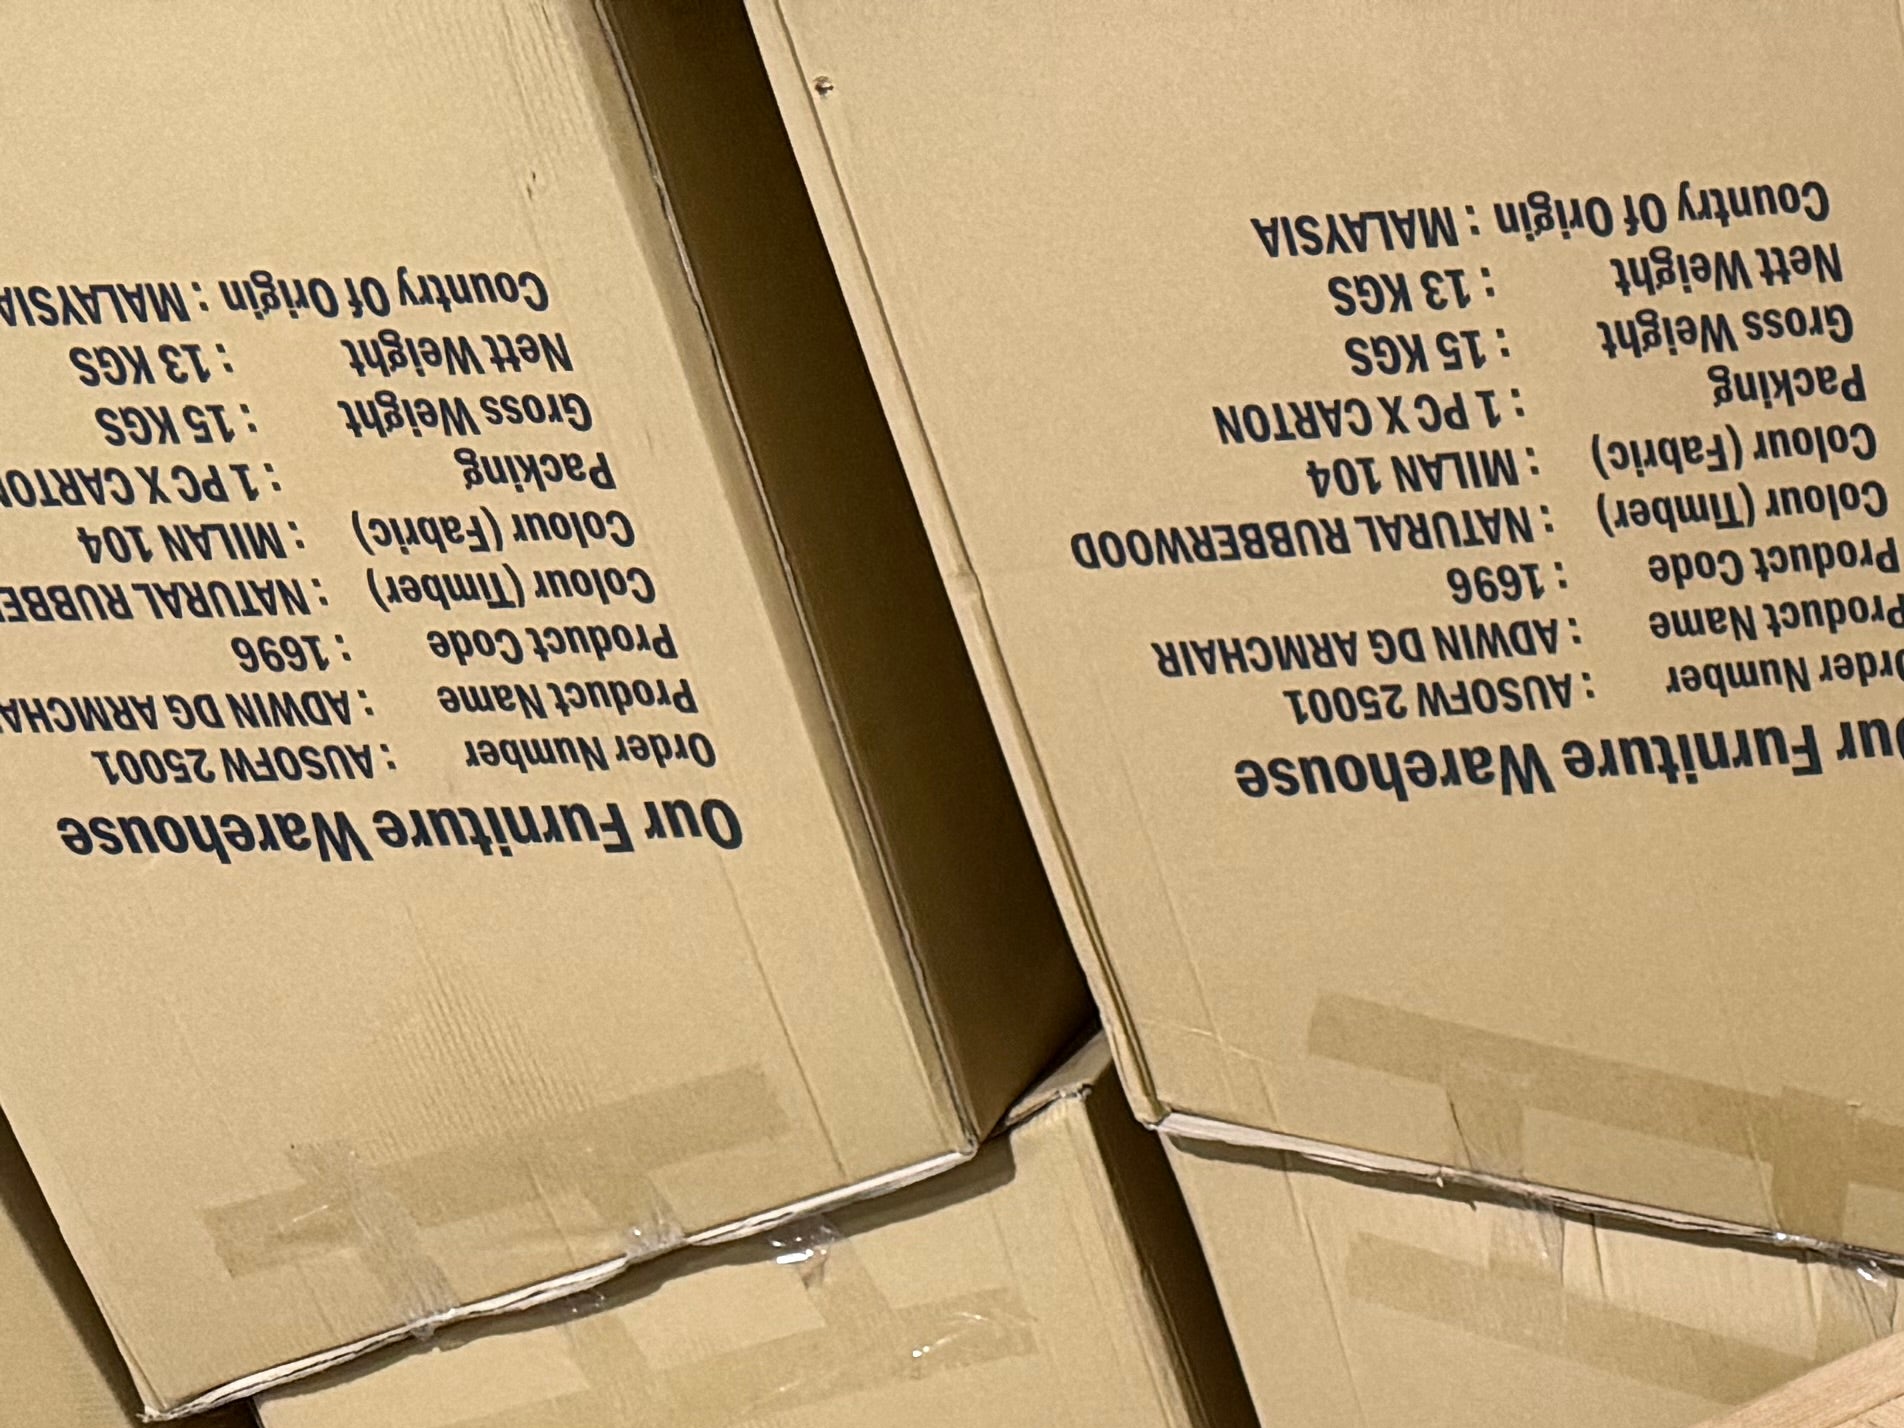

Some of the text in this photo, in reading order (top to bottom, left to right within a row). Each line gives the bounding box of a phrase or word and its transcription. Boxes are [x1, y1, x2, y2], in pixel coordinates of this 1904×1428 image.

[1249, 180, 1830, 258] Country Of Origin MALAYSIA
[94, 389, 593, 447] Gross Weight 15 KGS
[76, 505, 636, 565] Colour (Fabric) MILAN 104
[1070, 479, 1889, 570] Colour (Timber) NATURAL RUBBERWOOD
[230, 623, 679, 674] Product Code 1696
[1366, 626, 1427, 665] DG
[1431, 618, 1558, 662] ADWIN
[1648, 604, 1758, 642] Name
[1150, 630, 1358, 678] ARMCHAIR
[90, 732, 717, 786] Order Number AUSOFW 25001
[1234, 742, 1557, 803] Warehouse
[1561, 724, 1824, 785] Furniture
[56, 798, 743, 865] Our Furniture Warehouse
